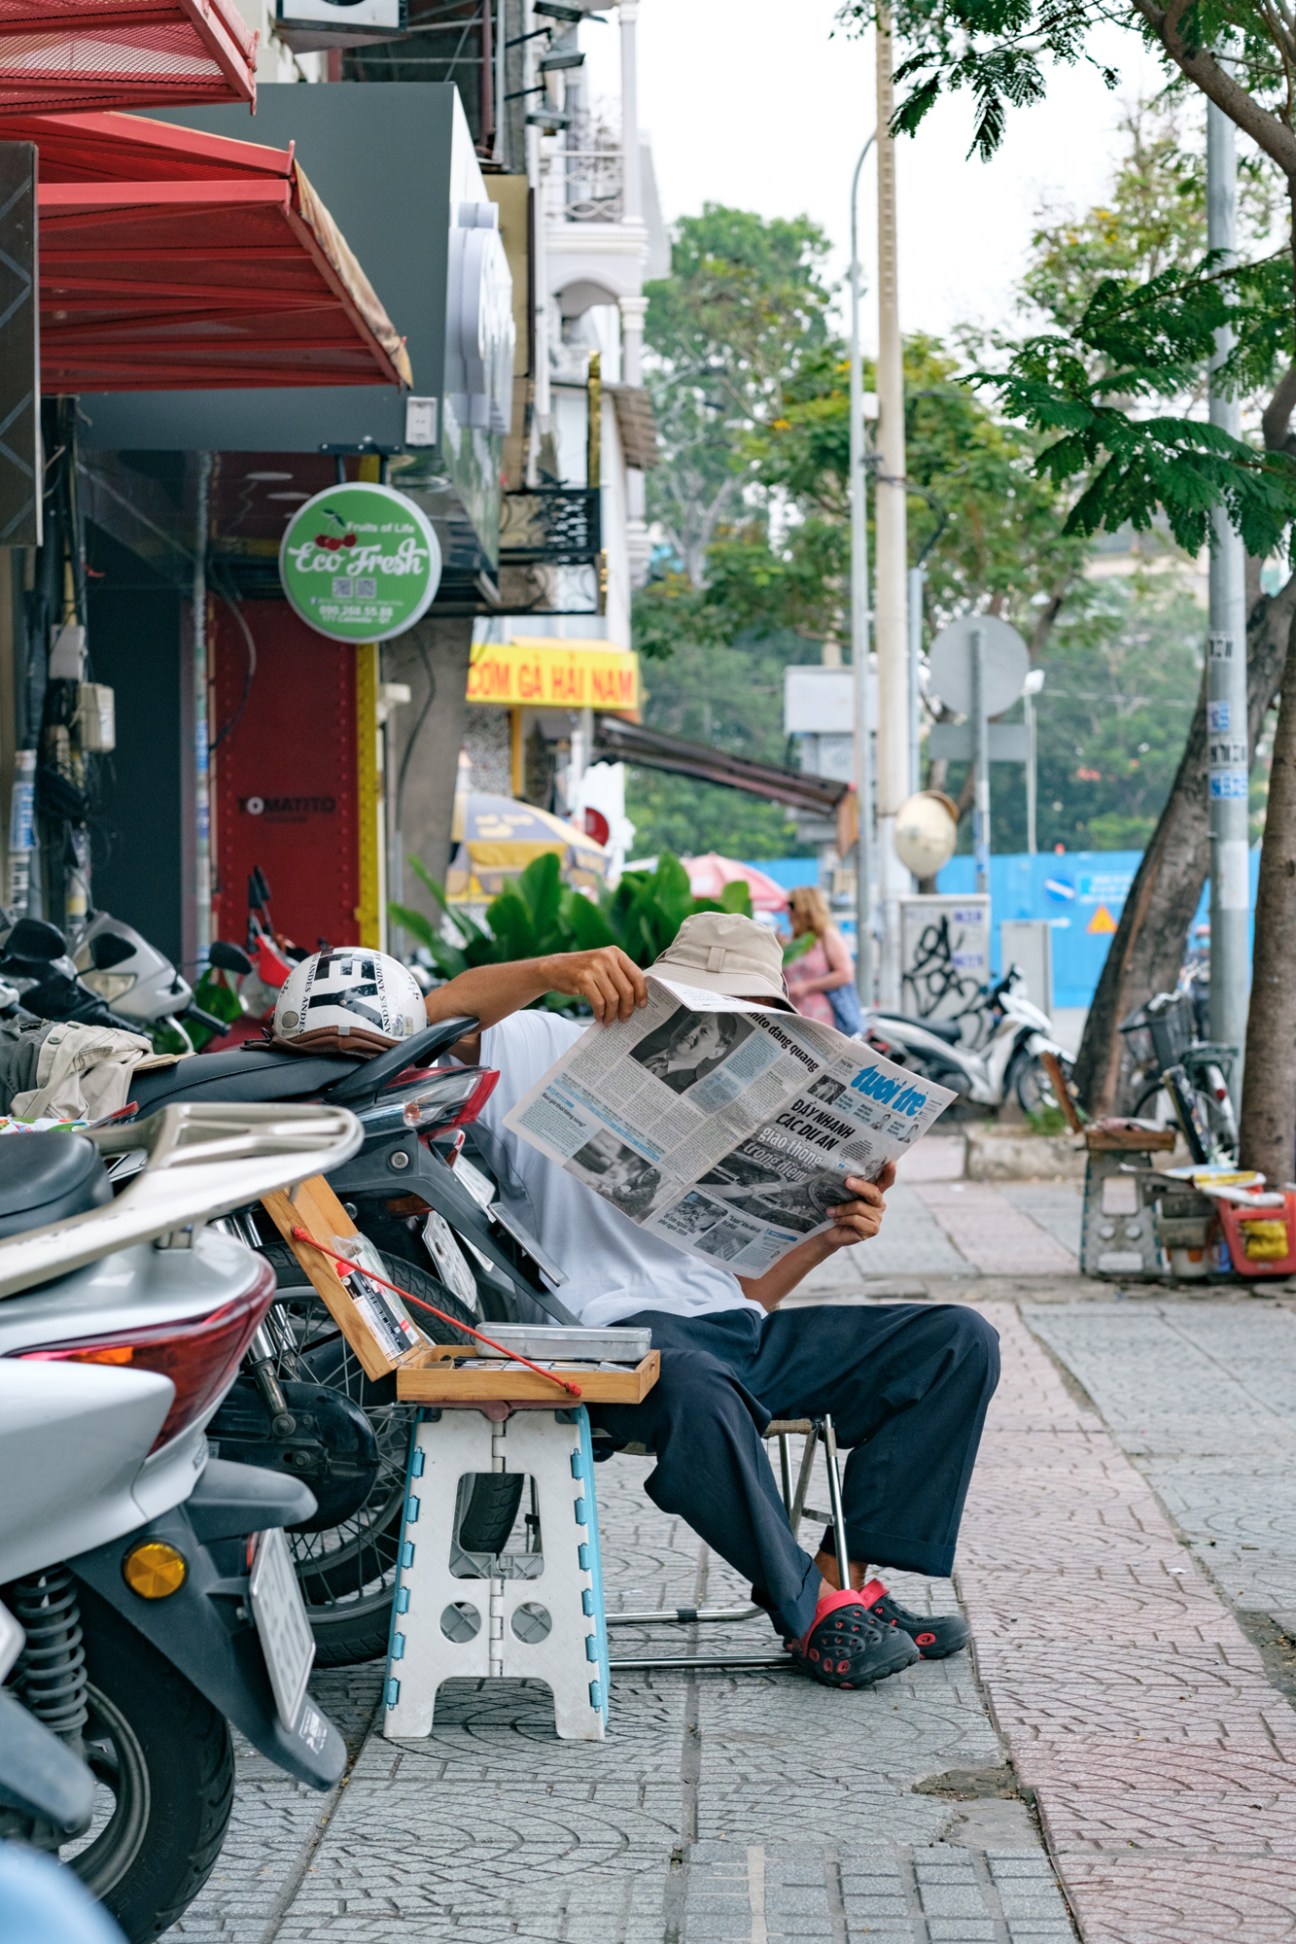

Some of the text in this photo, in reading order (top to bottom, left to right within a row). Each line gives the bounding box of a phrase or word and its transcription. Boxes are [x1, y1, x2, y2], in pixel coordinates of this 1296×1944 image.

[346, 521, 415, 534] Fruits of Life
[287, 537, 429, 577] Eco Fresh
[592, 667, 633, 704] NAM
[304, 962, 318, 993] ANDES
[308, 948, 384, 1031] EY
[379, 994, 392, 1034] ANDES
[789, 1045, 819, 1073] quang
[775, 1113, 804, 1131] CÁC
[797, 1123, 824, 1142] DỰ
[814, 1132, 840, 1151] ÁN
[790, 1098, 820, 1118] ĐẨY
[812, 1111, 856, 1139] NHANH
[757, 1126, 788, 1148] giao
[786, 1139, 824, 1169] thông
